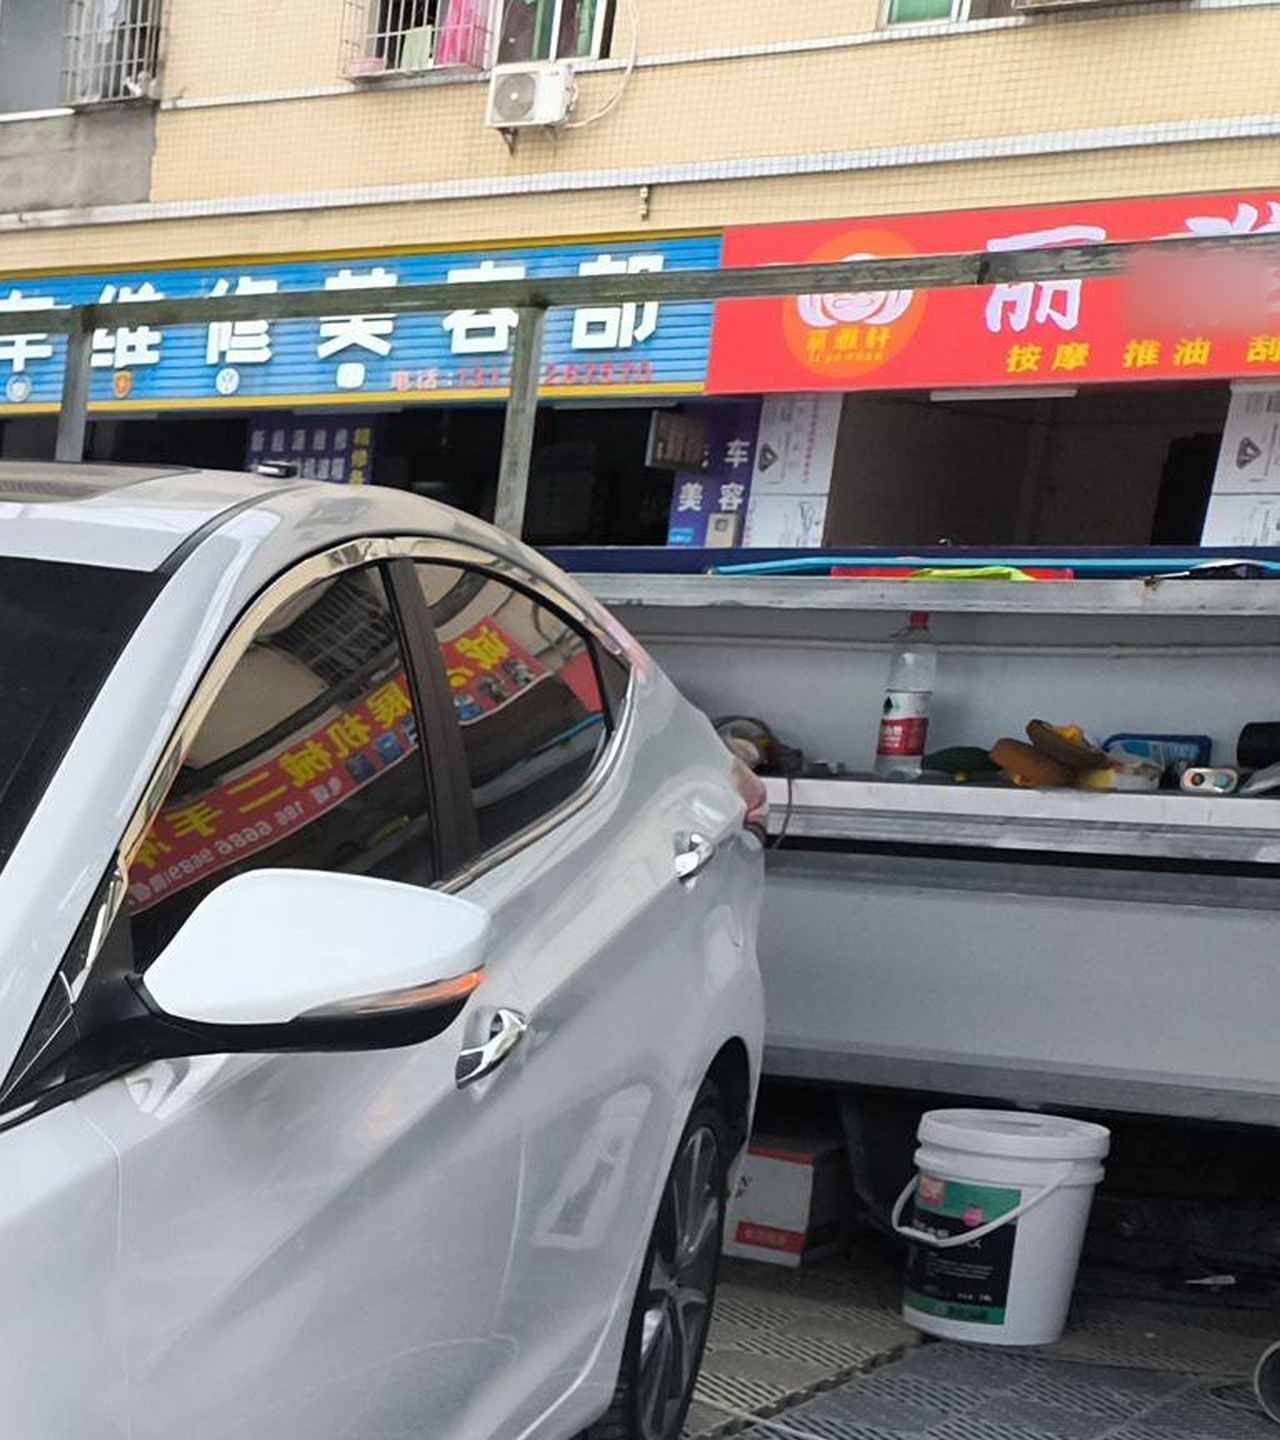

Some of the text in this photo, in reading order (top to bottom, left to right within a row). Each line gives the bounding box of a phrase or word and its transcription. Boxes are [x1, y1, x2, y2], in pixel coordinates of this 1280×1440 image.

[1006, 343, 1089, 372] 按摩
[1122, 339, 1210, 367] 推油
[677, 482, 744, 512] 美容
